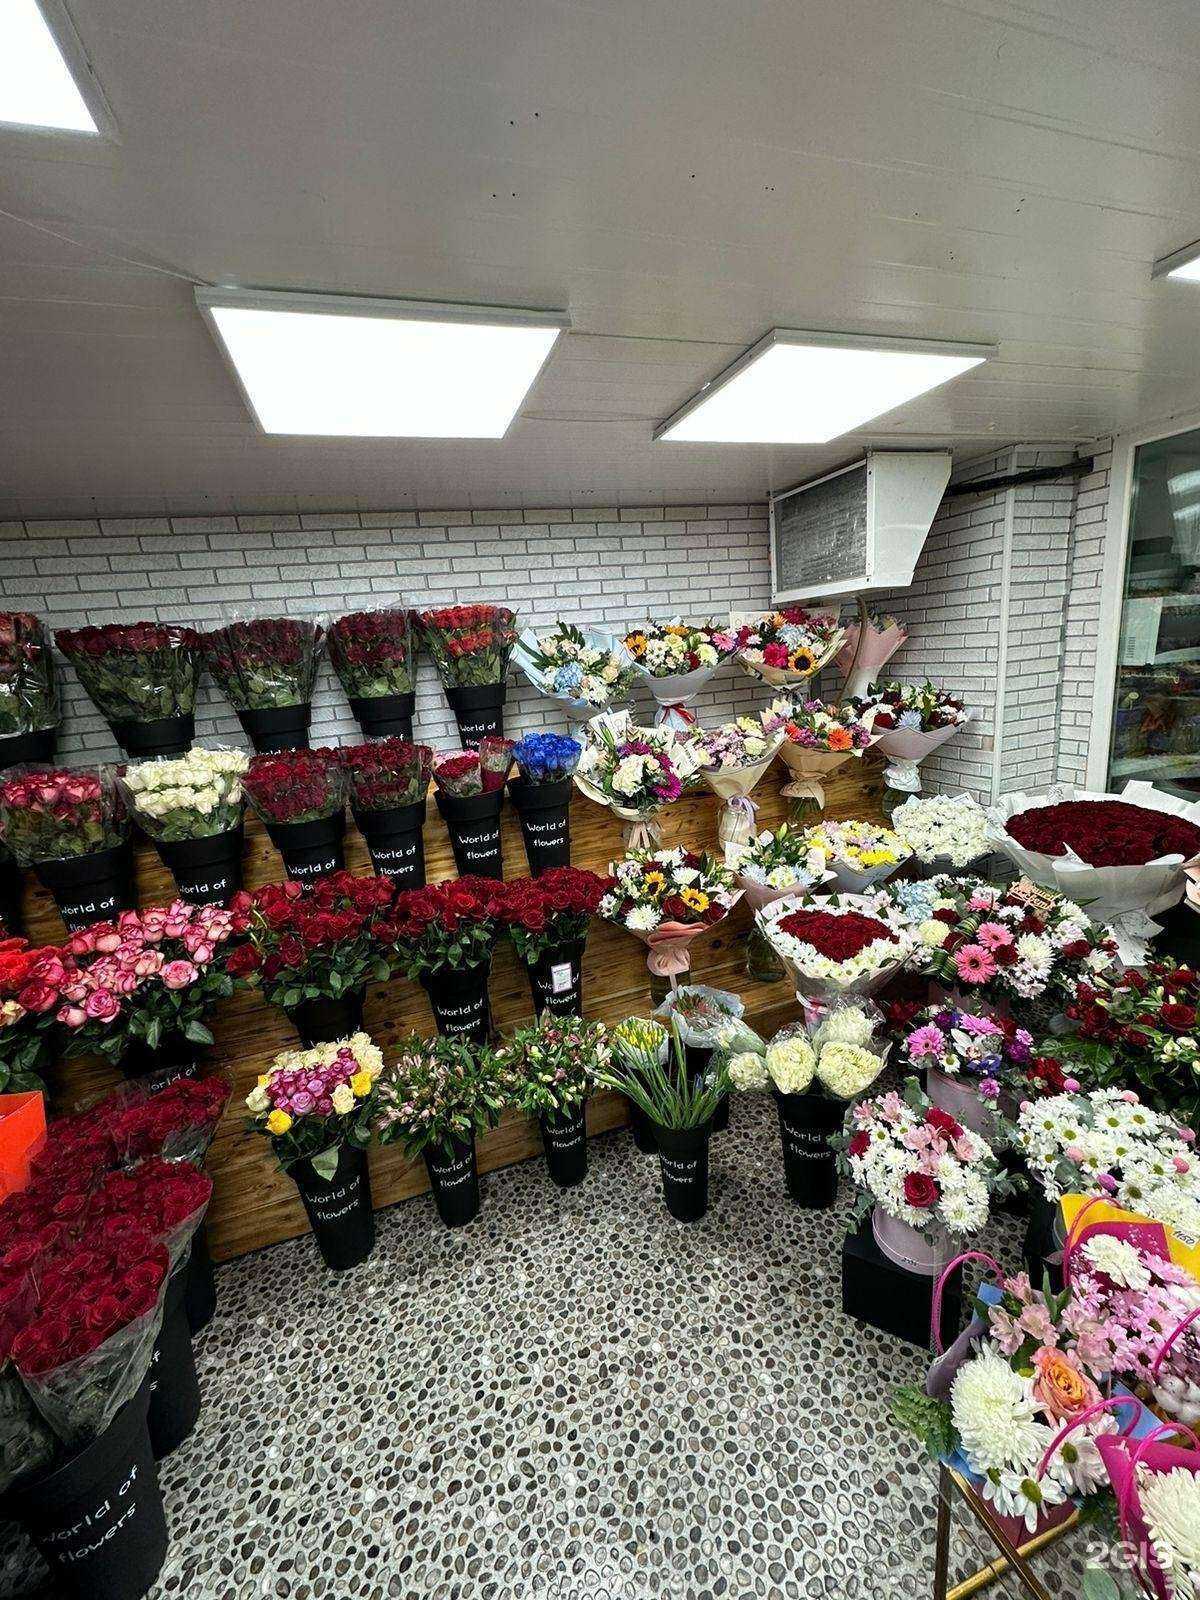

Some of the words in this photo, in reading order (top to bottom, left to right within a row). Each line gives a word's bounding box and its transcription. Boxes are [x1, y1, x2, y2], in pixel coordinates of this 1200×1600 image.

[487, 722, 497, 731] of
[527, 822, 556, 832] World
[558, 818, 566, 828] of
[459, 835, 490, 844] World
[491, 829, 499, 839] of
[533, 837, 564, 847] flowers
[373, 850, 403, 860] World
[406, 845, 416, 855] of
[466, 848, 498, 859] flowers
[289, 862, 321, 874] World
[325, 859, 336, 869] of
[380, 865, 415, 875] flowers
[213, 879, 226, 889] of
[100, 897, 115, 909] of
[545, 992, 578, 1005] flowers
[437, 1005, 471, 1017] World
[474, 998, 483, 1010] of
[445, 1018, 481, 1032] flowers
[546, 1124, 575, 1136] World
[576, 1118, 584, 1132] of
[784, 1120, 821, 1142] World
[552, 1136, 582, 1148] flowers
[790, 1143, 831, 1159] flowers
[432, 1161, 463, 1174] World
[465, 1152, 473, 1165] of
[686, 1160, 697, 1169] of
[440, 1171, 472, 1187] flowers
[305, 1188, 346, 1203] World
[349, 1175, 360, 1190] of
[317, 1199, 359, 1220] flowers
[119, 1464, 138, 1495] of
[59, 1503, 136, 1562] flowers
